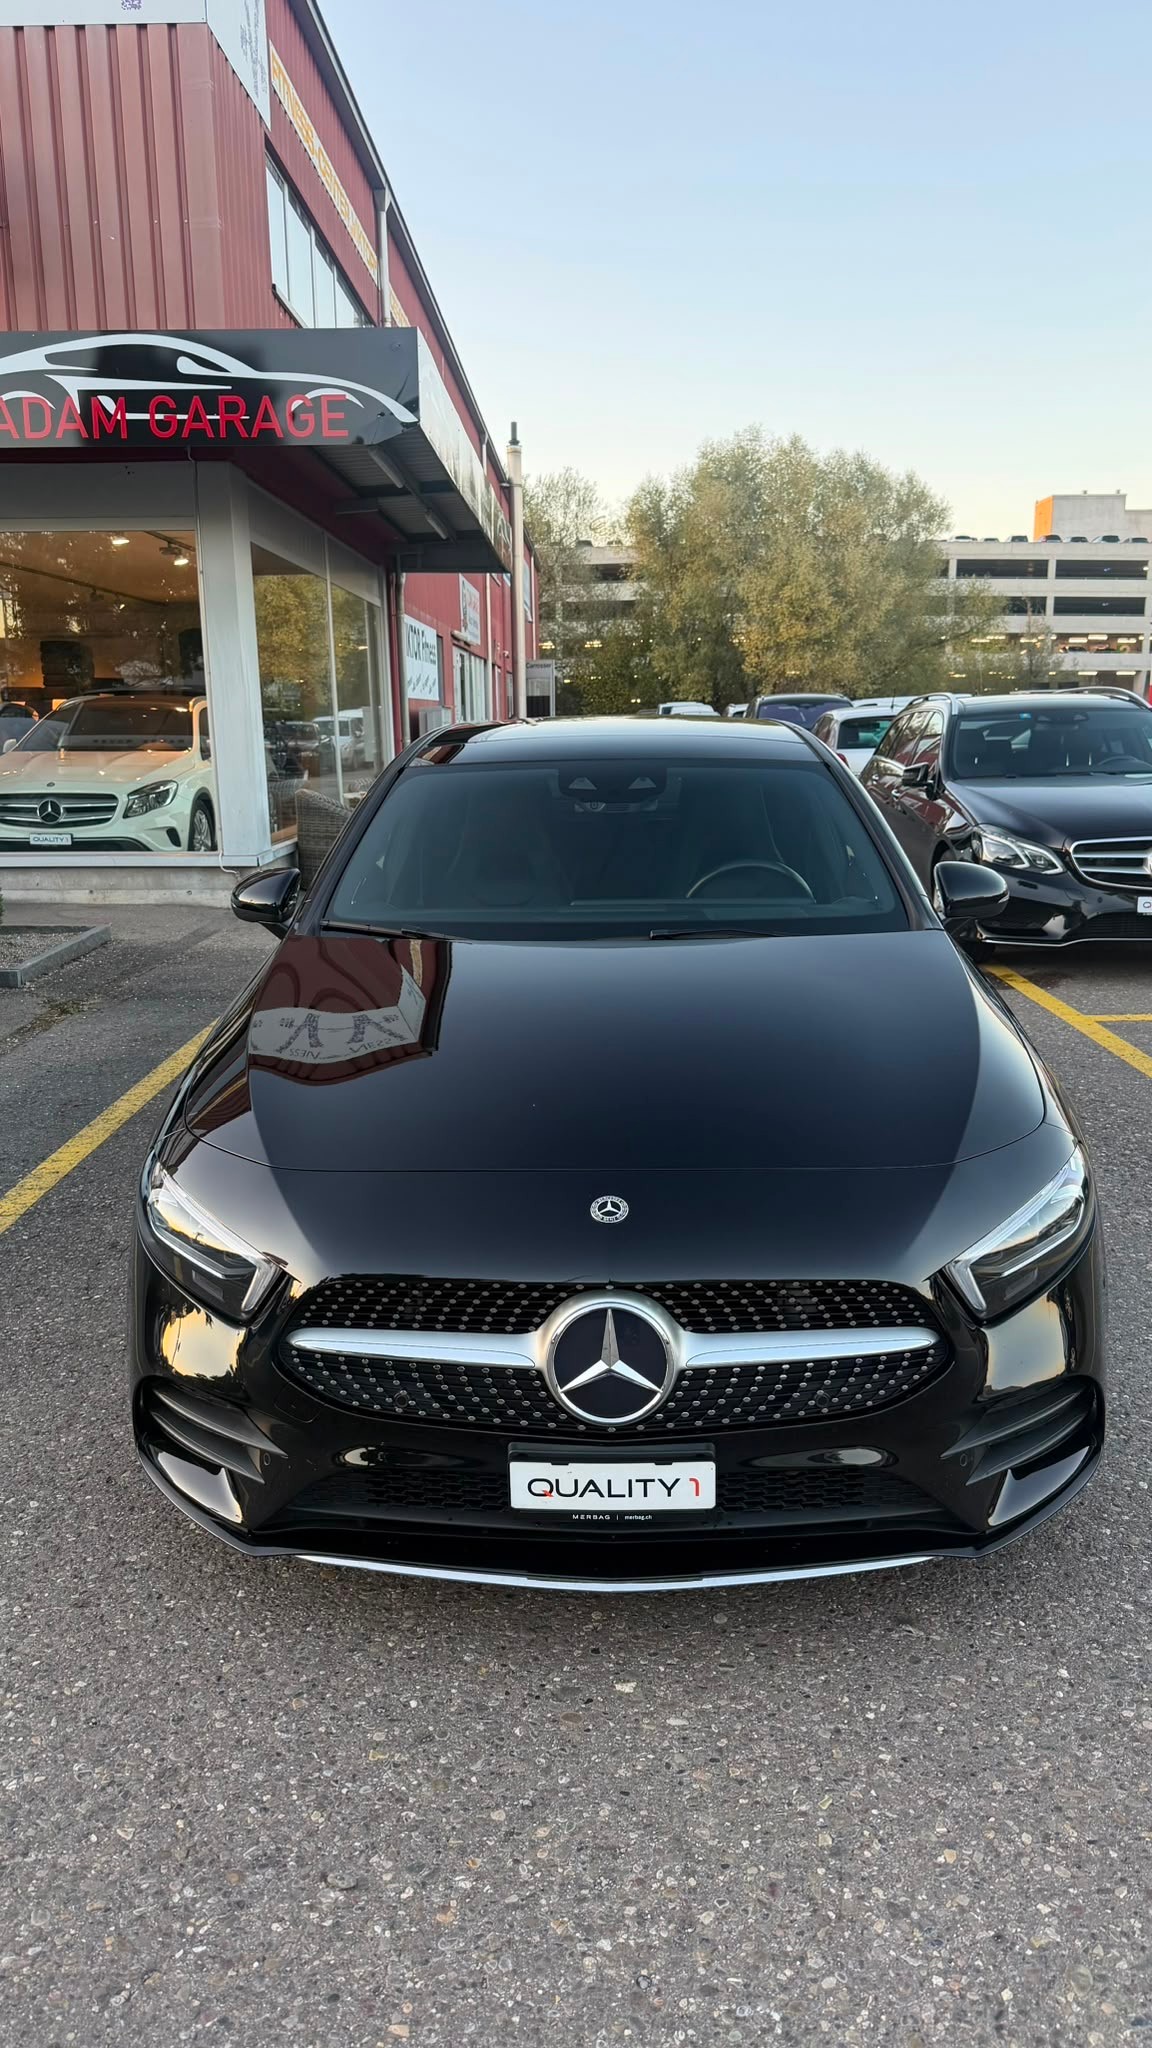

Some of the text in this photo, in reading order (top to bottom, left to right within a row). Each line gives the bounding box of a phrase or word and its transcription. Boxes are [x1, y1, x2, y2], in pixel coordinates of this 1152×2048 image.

[0, 394, 349, 440] ADAM GARAGE
[527, 1477, 700, 1498] QUALITY 1
